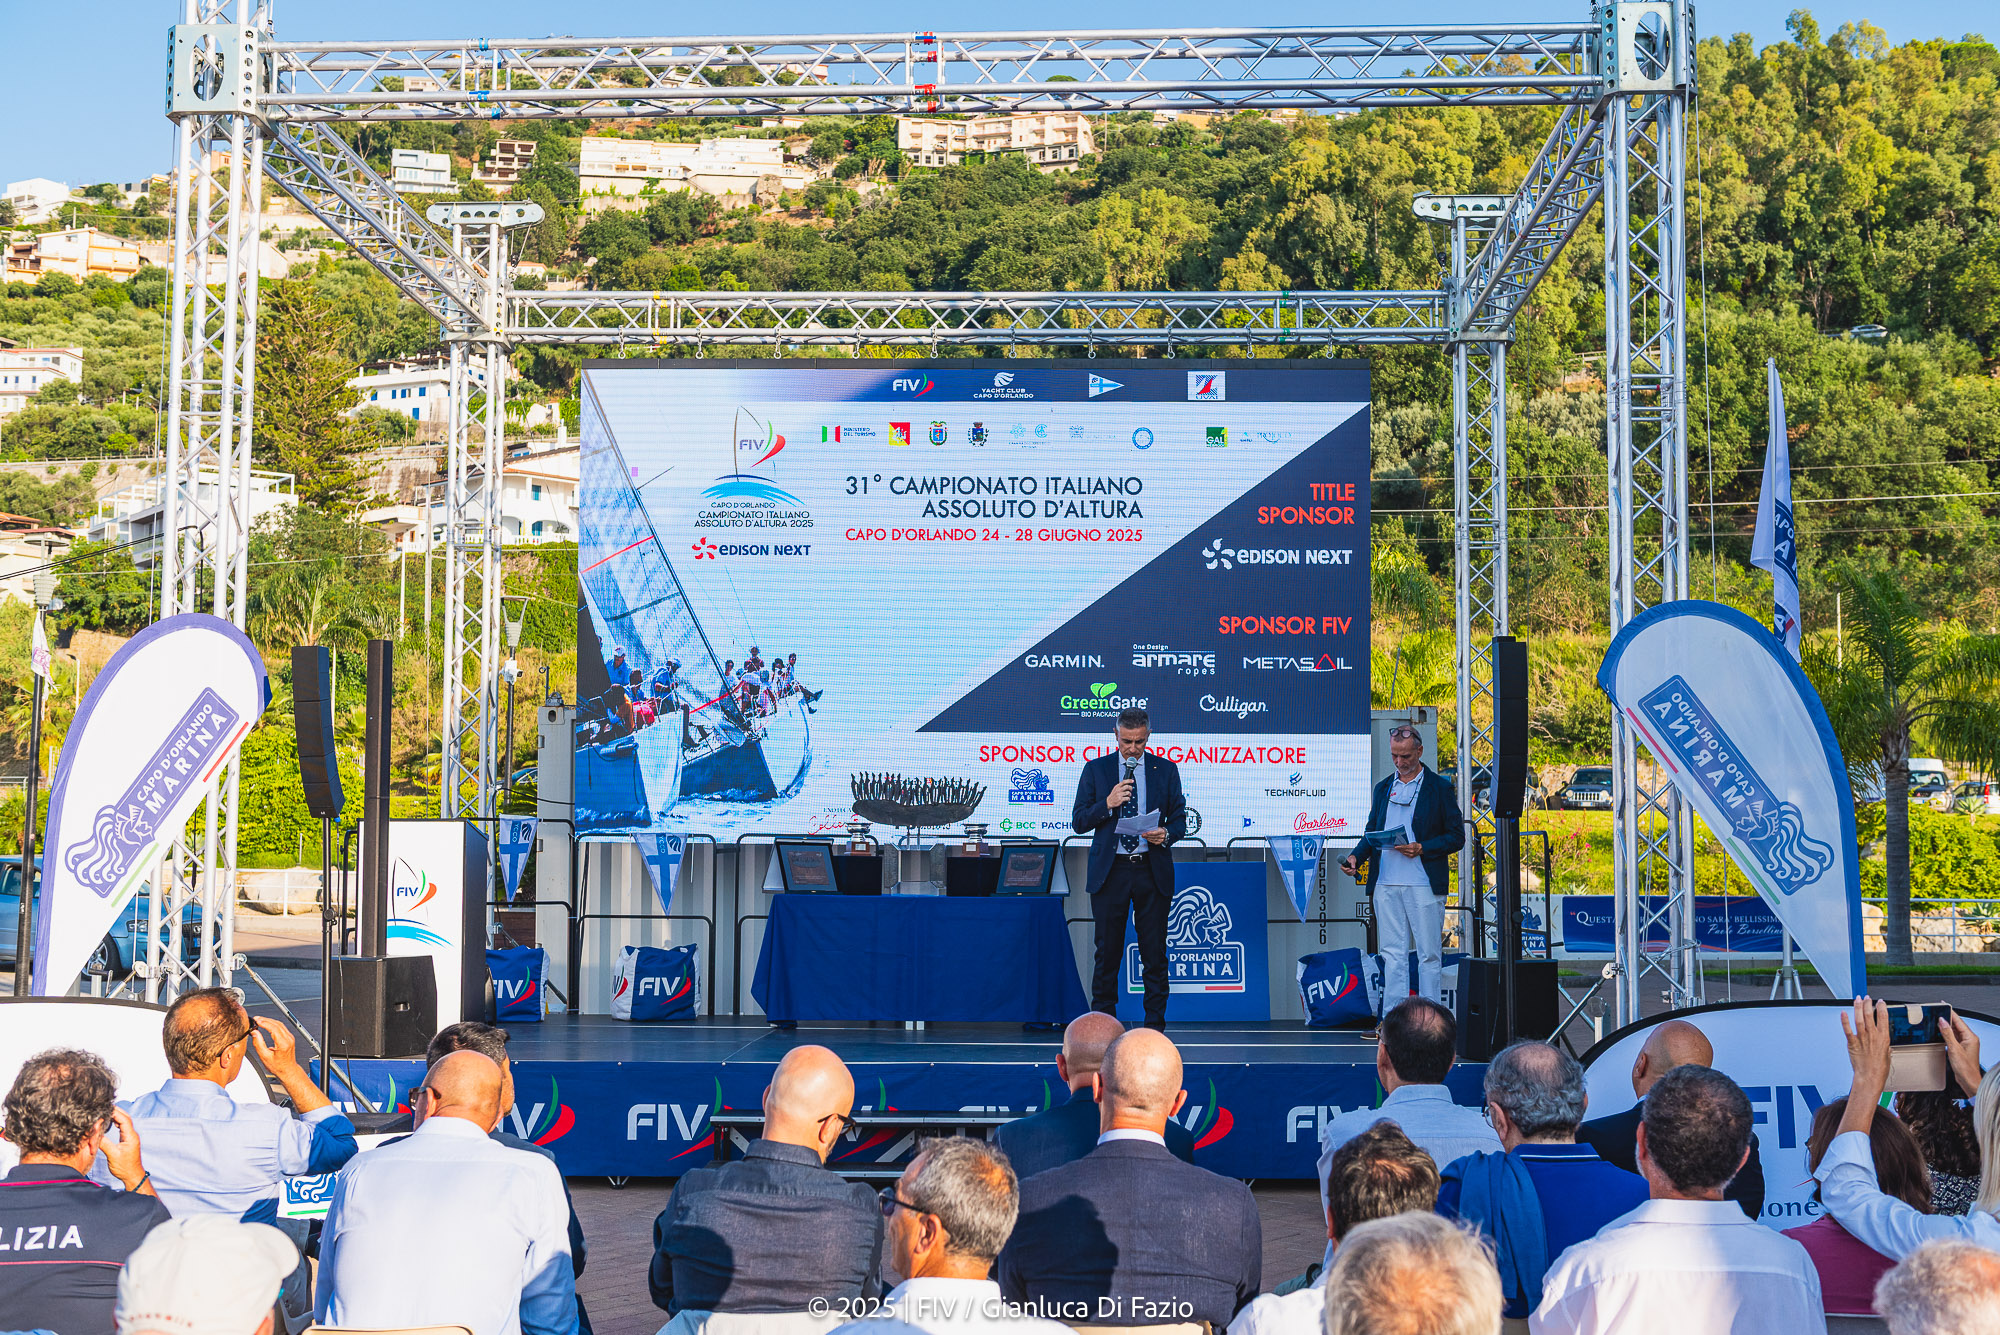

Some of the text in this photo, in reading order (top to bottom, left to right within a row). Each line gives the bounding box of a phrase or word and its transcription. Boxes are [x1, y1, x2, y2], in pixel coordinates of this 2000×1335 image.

[892, 378, 921, 391] FIV
[740, 439, 765, 451] FIV
[890, 476, 1037, 495] CAMPIONATO
[1046, 476, 1143, 495] ITALIANO
[1310, 483, 1355, 501] TITLE
[698, 510, 810, 519] CAMPIONATO ITALIANO
[921, 500, 1144, 518] ASSOLUTO D'ALTURA
[1257, 506, 1355, 525] SPONSOR
[694, 519, 814, 528] ASSOLUTO D'ALTURA 2025
[845, 528, 887, 542] CAPO
[891, 528, 977, 542] D'ORLANDO
[981, 528, 1001, 542] 24
[1015, 528, 1034, 542] 28
[1038, 528, 1102, 542] GIUGNO
[1106, 528, 1143, 542] 2025
[1219, 616, 1353, 636] SPONSOR FIV
[1132, 642, 1169, 652] One Design
[1132, 653, 1216, 668] armare
[1177, 667, 1216, 677] ropes
[1060, 695, 1149, 711] GreenGate
[136, 703, 213, 802] CAPO D'ORLANDO
[978, 745, 1075, 763] SPONSOR
[143, 712, 228, 815] MARINA
[1264, 788, 1327, 797] TECHNOFLUID
[1015, 821, 1037, 830] BCC
[1293, 811, 1348, 832] Barbera
[396, 886, 419, 897] FIV
[1169, 951, 1232, 962] D'ORLANDO
[638, 976, 681, 996] FIV
[1307, 975, 1342, 1004] FIV
[627, 1103, 709, 1141] FIV
